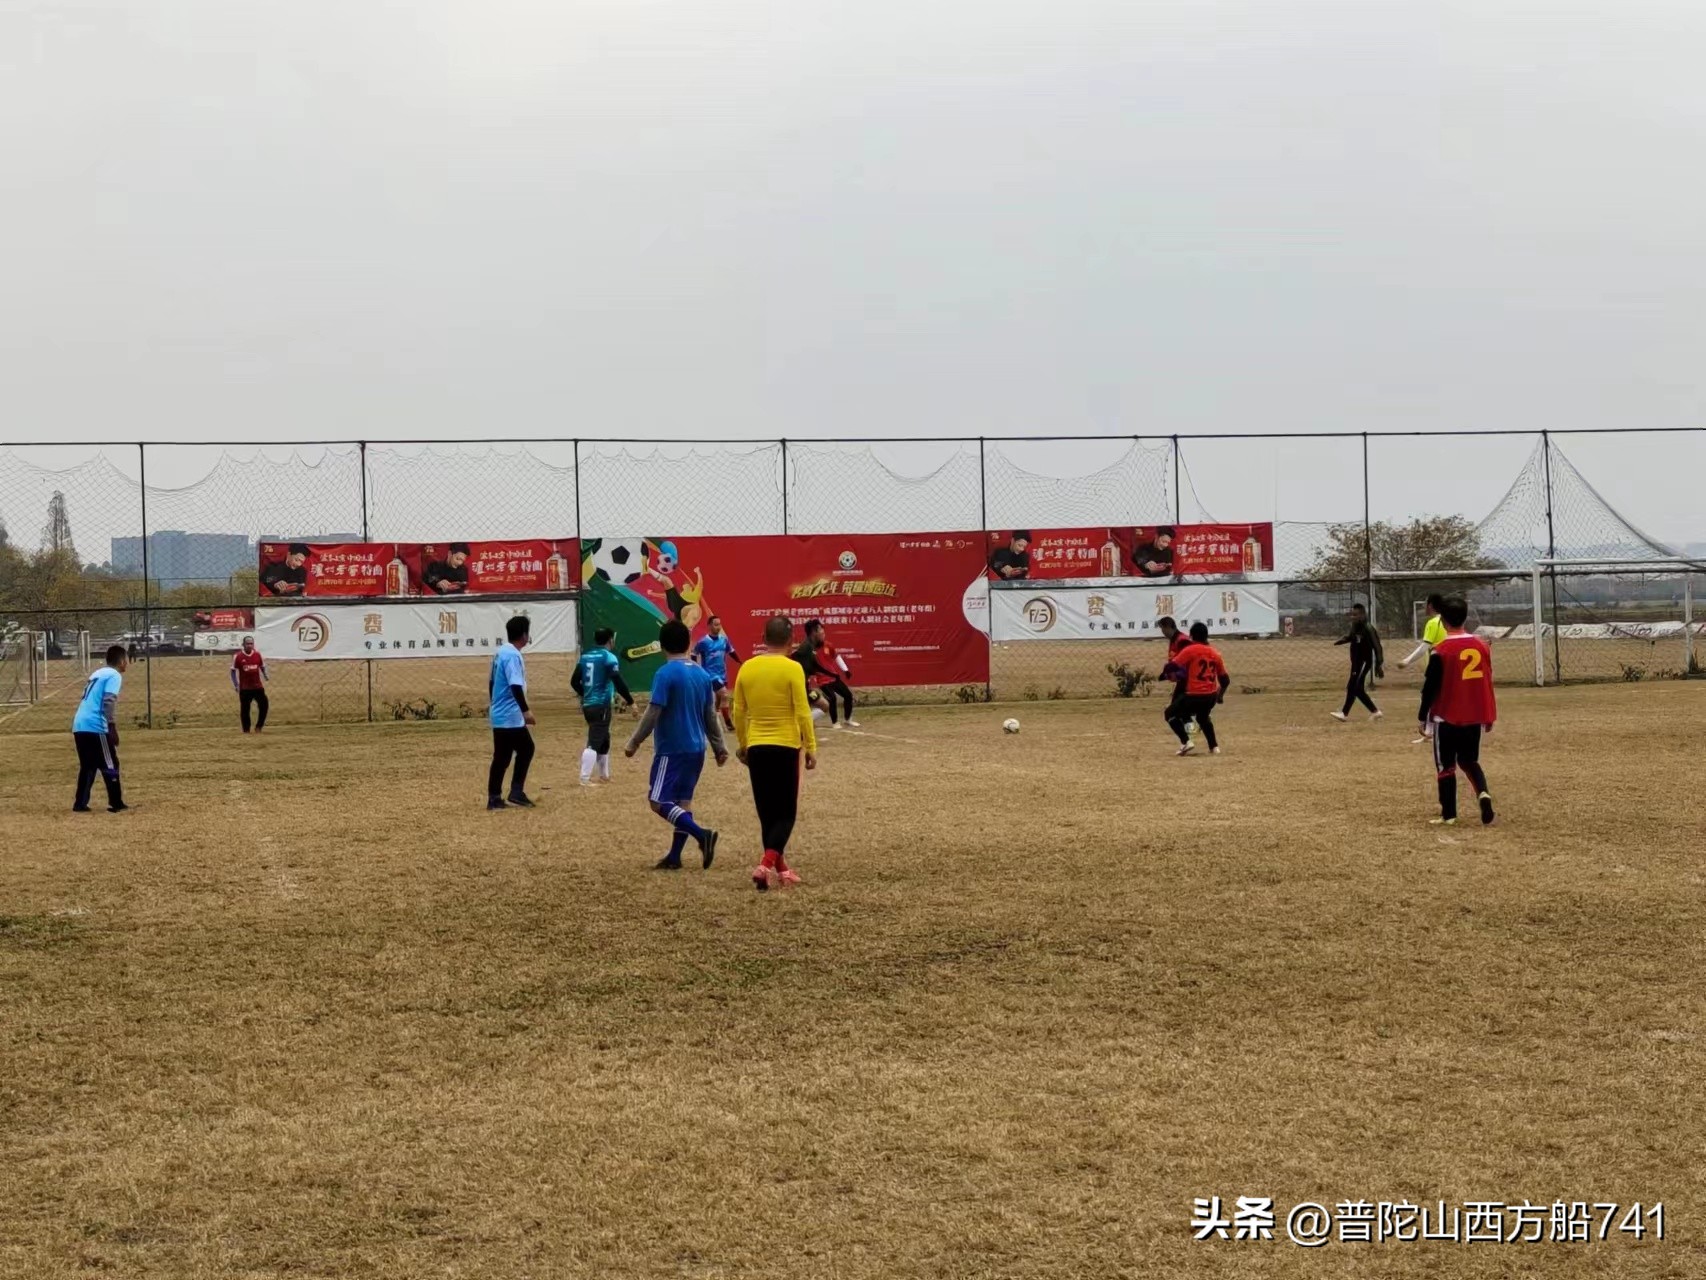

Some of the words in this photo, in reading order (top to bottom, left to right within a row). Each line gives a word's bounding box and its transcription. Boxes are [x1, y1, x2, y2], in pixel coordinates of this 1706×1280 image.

[584, 662, 595, 687] 3
[1198, 658, 1217, 682] 23
[1459, 648, 1484, 681] 2
